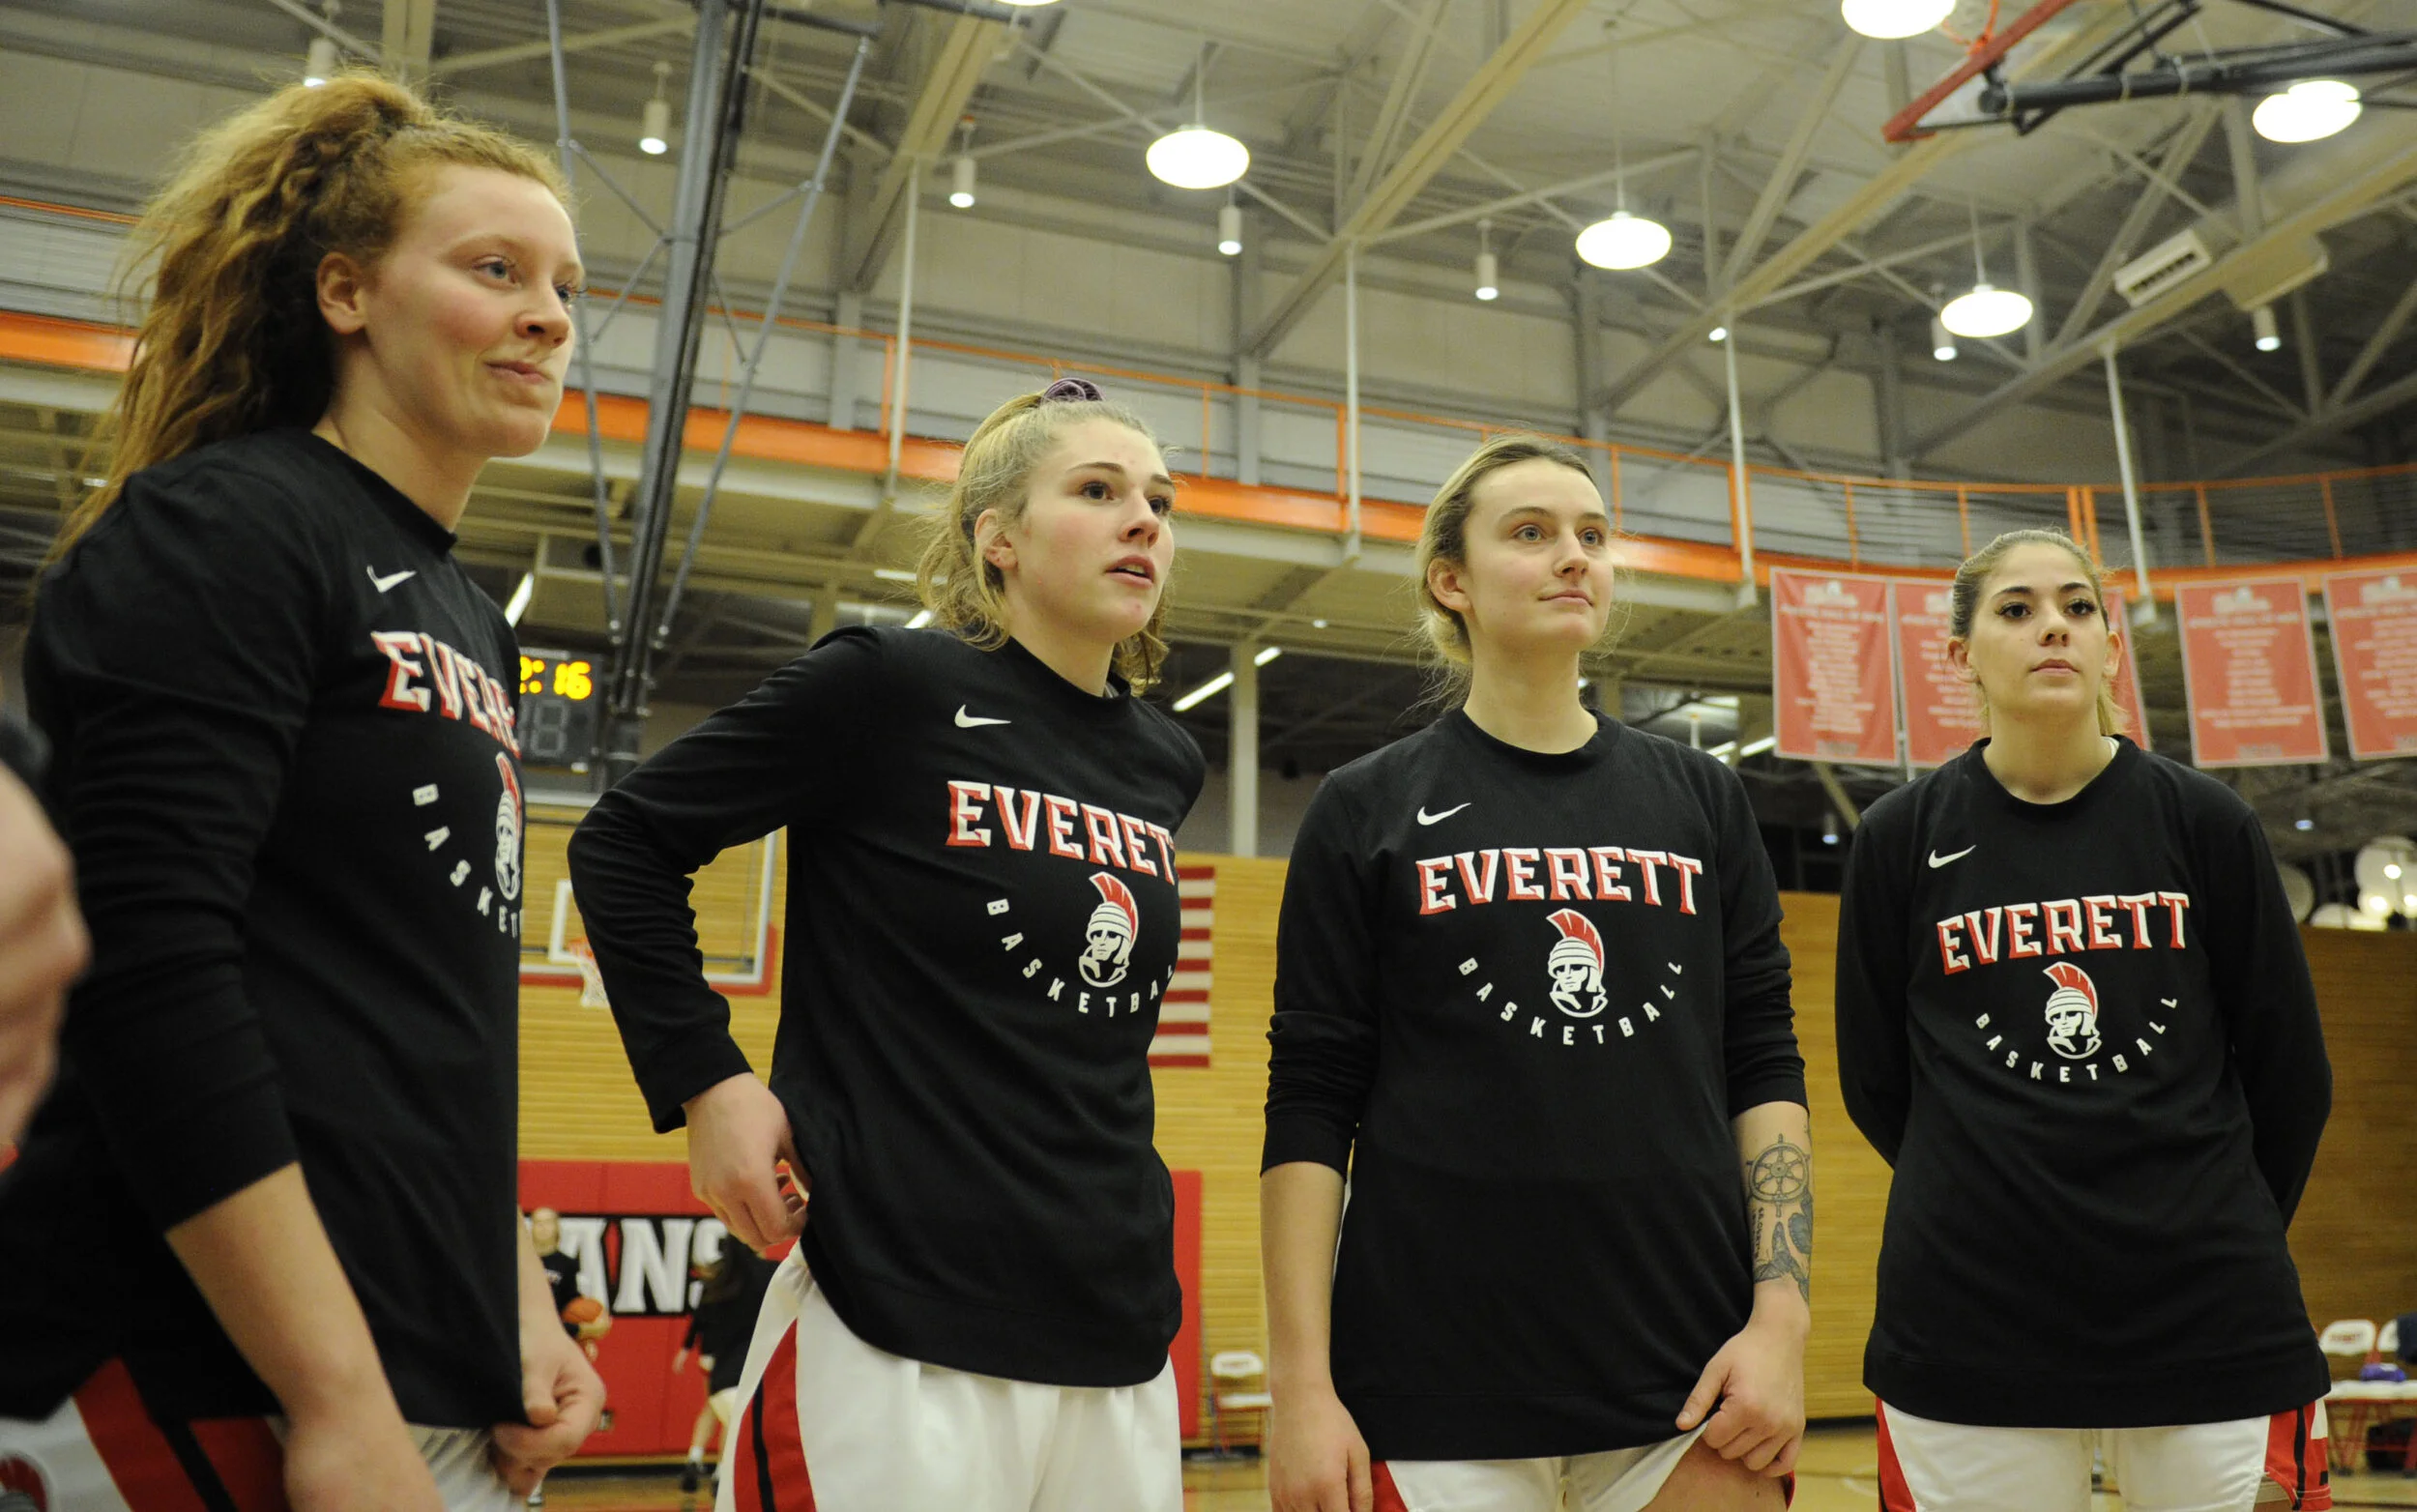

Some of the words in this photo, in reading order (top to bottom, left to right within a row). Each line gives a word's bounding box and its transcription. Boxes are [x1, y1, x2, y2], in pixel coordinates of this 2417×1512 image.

[946, 780, 1175, 886] EVERET
[1415, 847, 1703, 915] EVERETT
[987, 898, 1179, 1017] BASKETBAL
[1937, 891, 2189, 975] EVERETT
[1458, 957, 1682, 1045] BASKETBALL
[1975, 999, 2177, 1082] BASKETBALL
